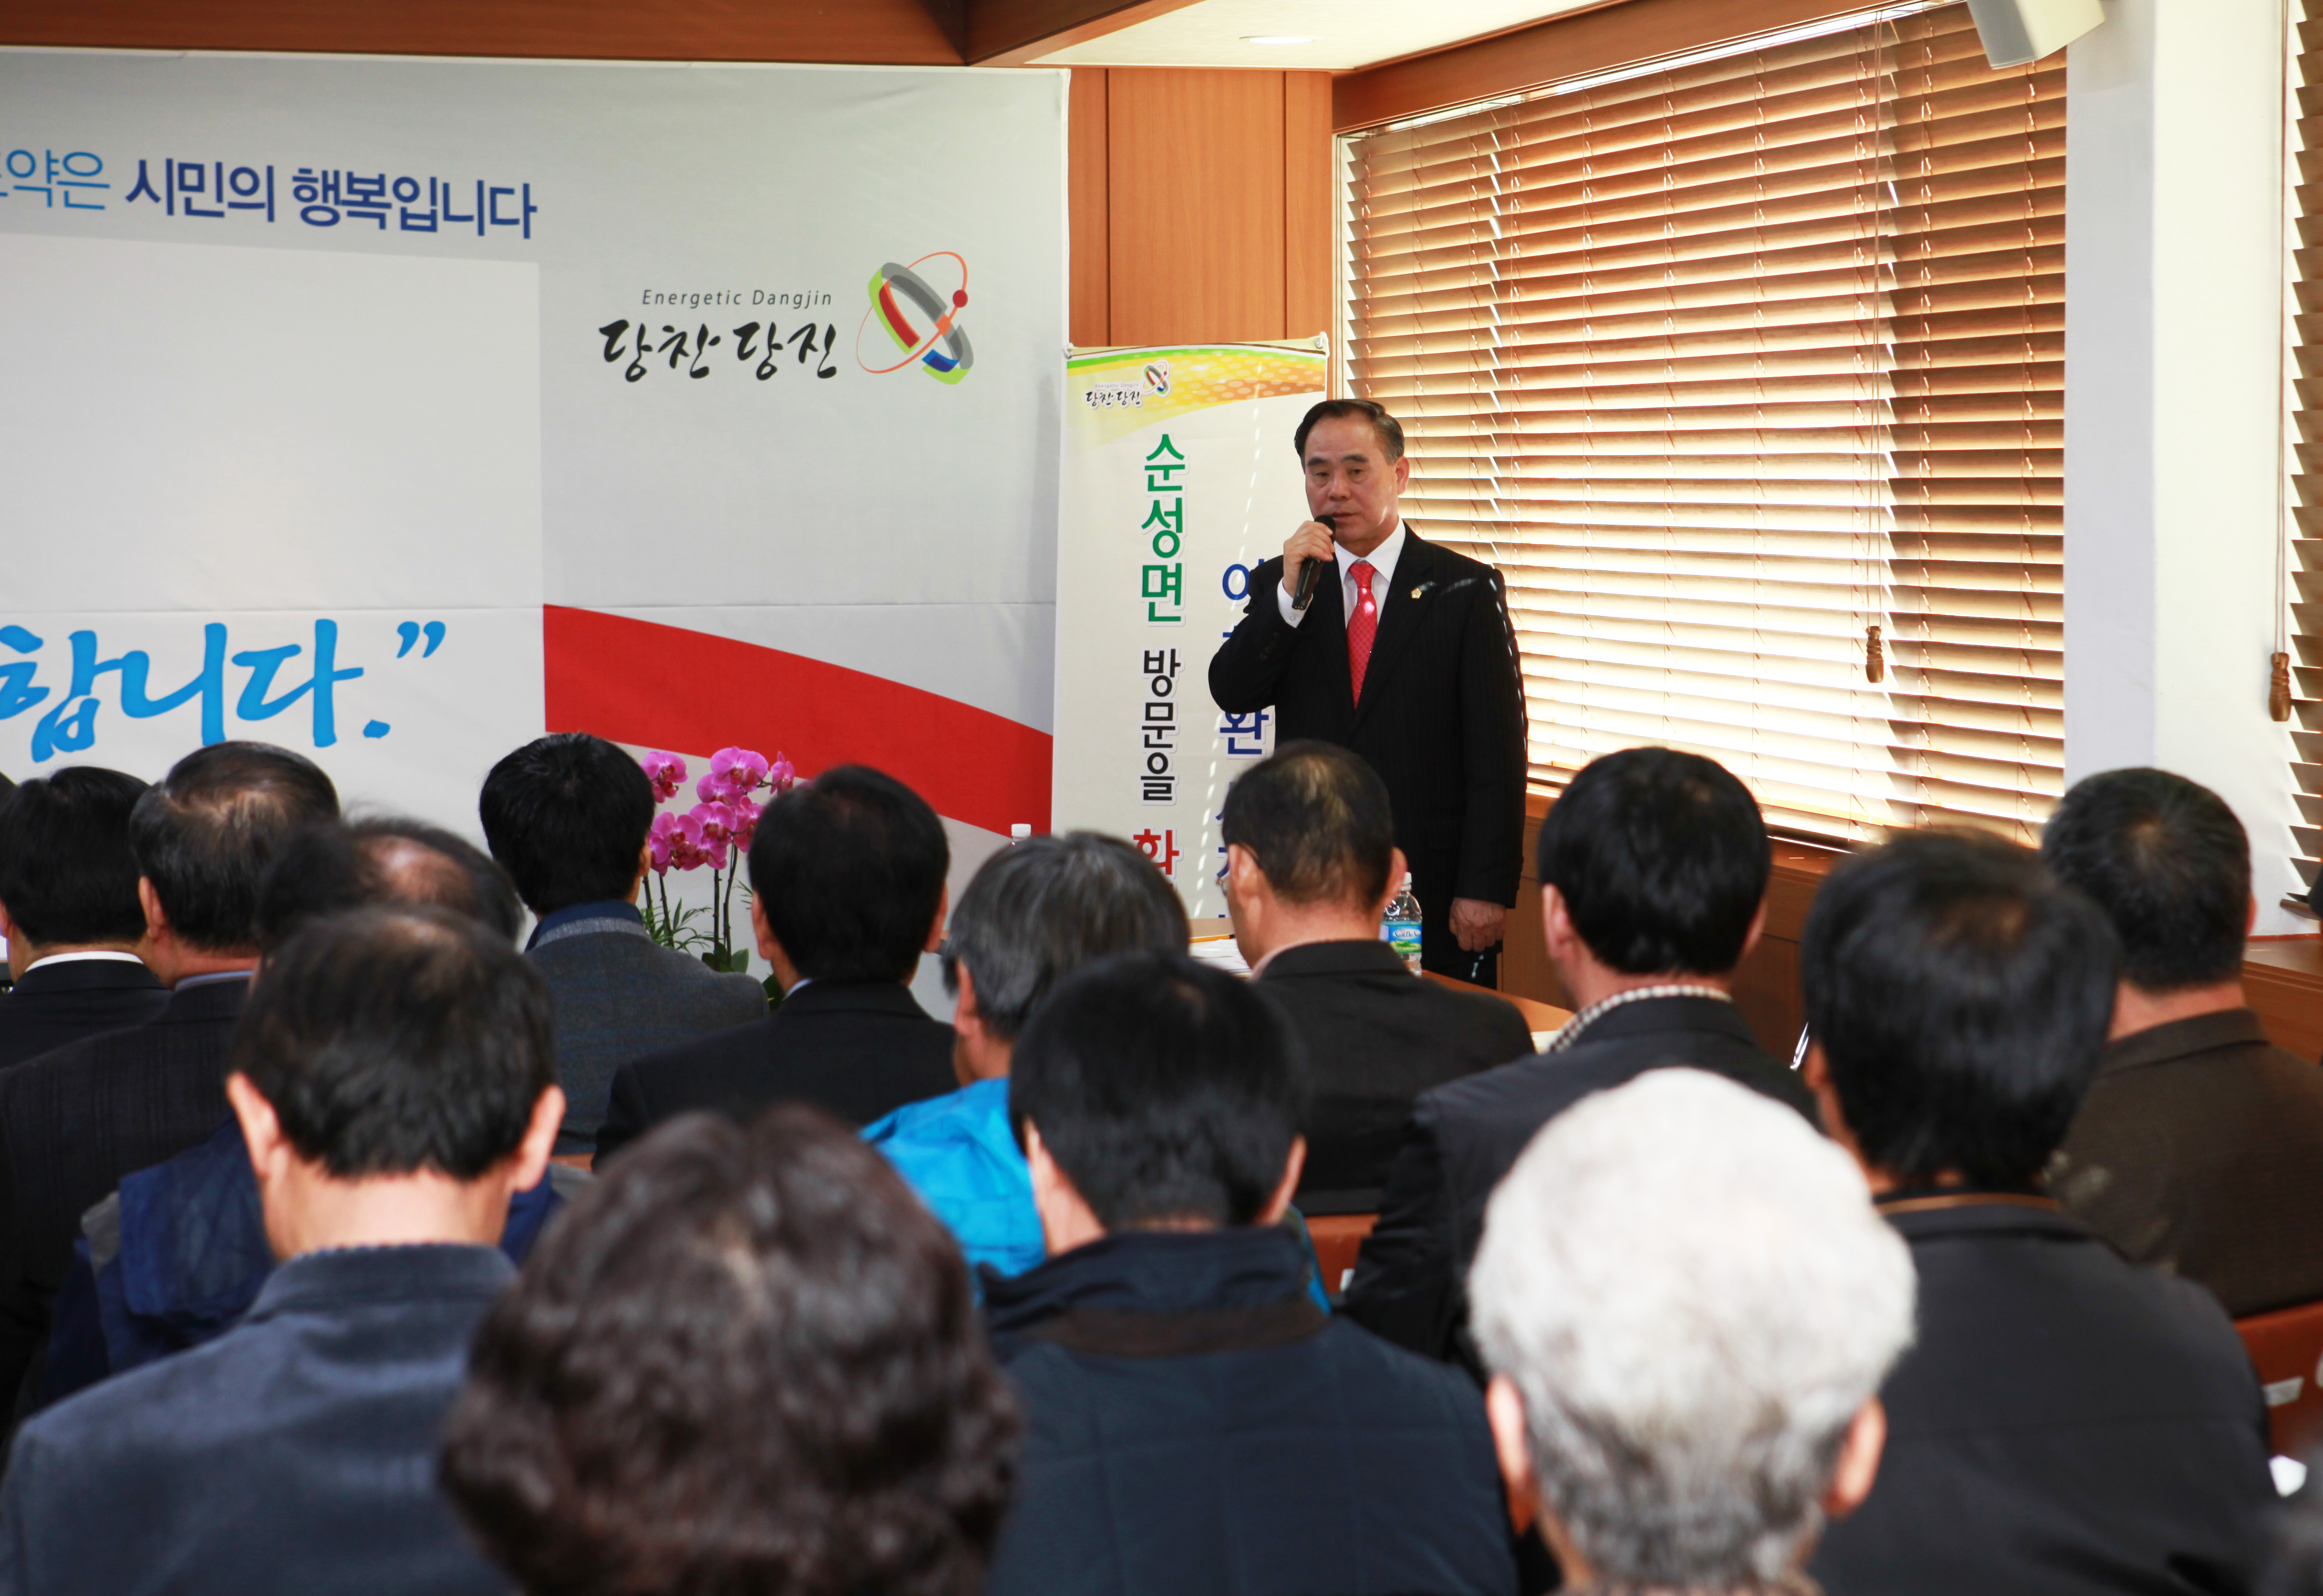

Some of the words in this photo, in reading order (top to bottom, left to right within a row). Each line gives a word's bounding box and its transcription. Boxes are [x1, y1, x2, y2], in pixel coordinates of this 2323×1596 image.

[0, 149, 110, 210] 약은
[125, 158, 274, 222] 시민의
[292, 167, 537, 239] 행복입니다
[642, 289, 742, 309] Energetic
[752, 290, 831, 309] Dangjin
[732, 321, 837, 381] 당진
[1141, 433, 1186, 622] 순성면
[1140, 648, 1181, 801] 방문을
